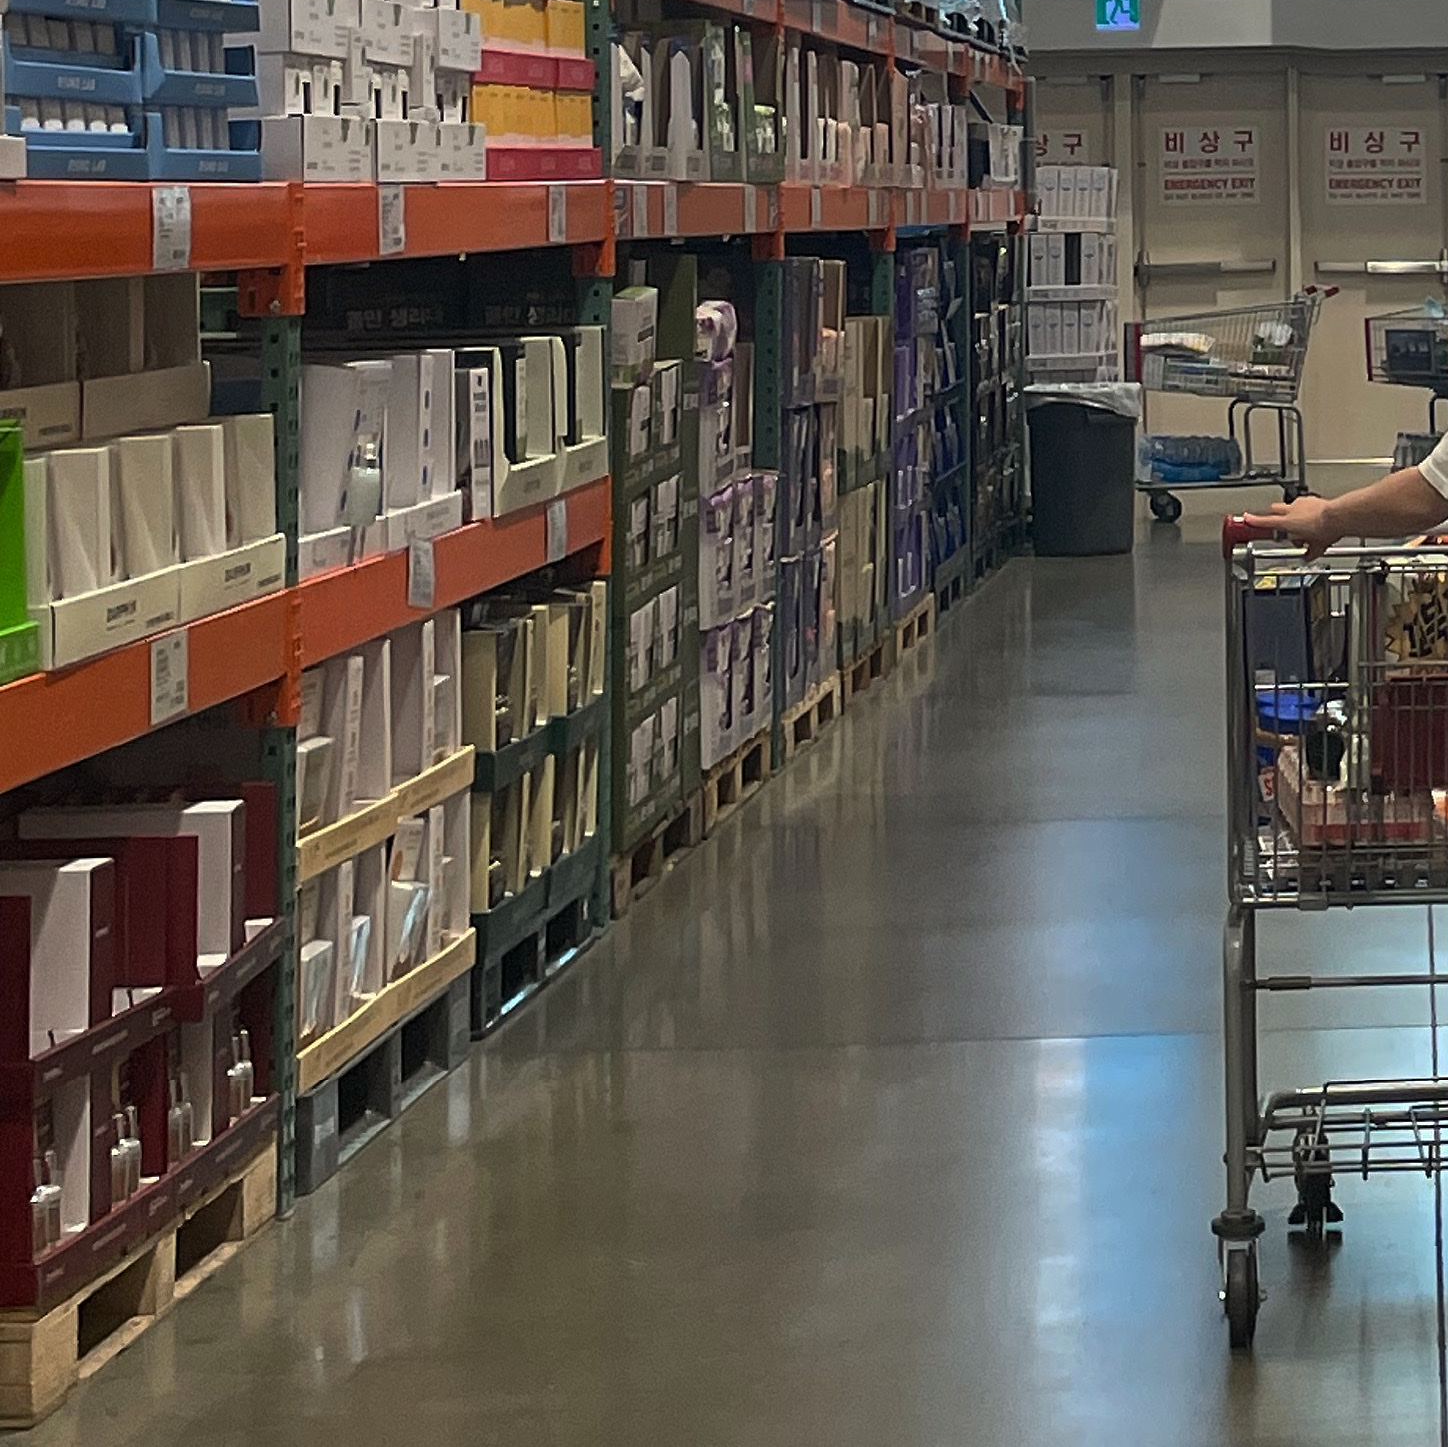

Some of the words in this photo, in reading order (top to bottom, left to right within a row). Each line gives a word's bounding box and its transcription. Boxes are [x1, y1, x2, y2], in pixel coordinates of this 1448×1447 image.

[1034, 133, 1083, 157] 상구
[1164, 130, 1254, 154] 비상구
[1330, 130, 1421, 154] 비상구
[1231, 177, 1256, 189] EXIT
[1397, 177, 1422, 189] EXIT
